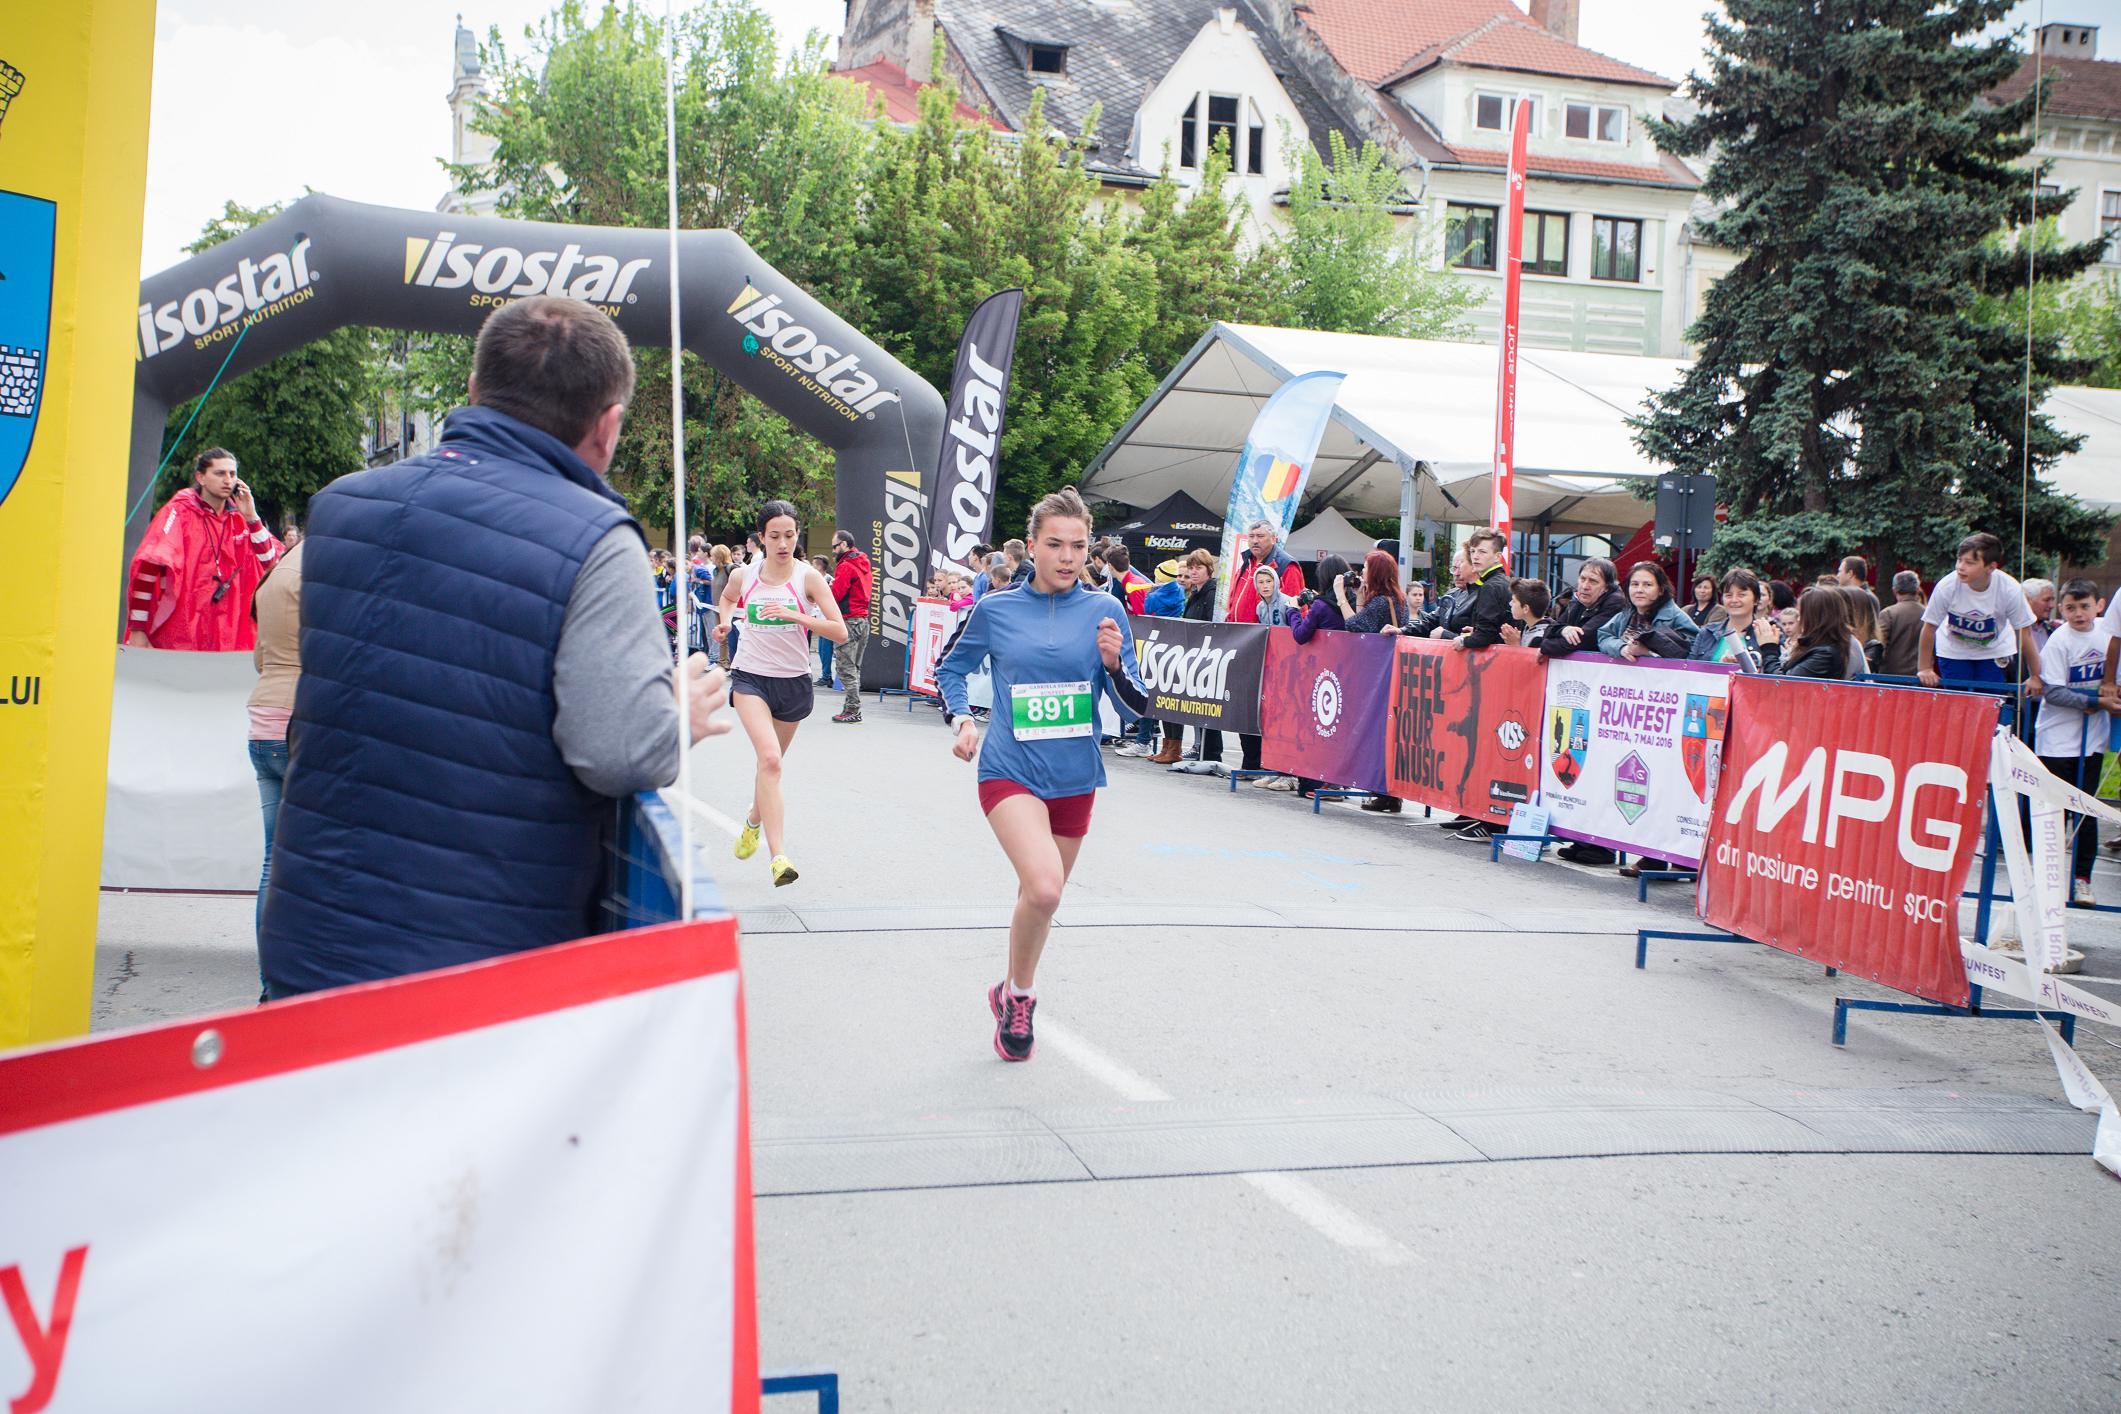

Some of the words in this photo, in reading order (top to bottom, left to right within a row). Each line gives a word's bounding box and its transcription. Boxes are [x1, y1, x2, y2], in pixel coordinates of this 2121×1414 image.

[415, 231, 652, 303] isostar
[139, 238, 311, 358] isostar
[194, 320, 240, 350] SPORT
[243, 286, 314, 327] NUTRITION
[469, 294, 514, 309] SPO
[733, 294, 901, 414] isostar
[760, 346, 800, 377] SPORT
[798, 375, 859, 422] NUTRITION
[931, 342, 1004, 579] isostar
[873, 520, 882, 563] SPORT
[1148, 535, 1189, 548] isostar
[1175, 522, 1222, 532] isostar
[871, 568, 881, 635] NUTRITION
[1955, 617, 1985, 632] 170
[1140, 630, 1237, 700] isostar
[1398, 652, 1444, 714] FEEL
[1027, 695, 1074, 721] 891
[1156, 696, 1179, 711] SPORT
[1181, 701, 1222, 717] NUTRITION
[1599, 700, 1677, 734] RUNFEST
[1600, 685, 1644, 701] GABRIELA
[1648, 690, 1679, 704] SZABO
[1393, 706, 1434, 749] YOUR
[1640, 735, 1654, 745] MAI
[1656, 737, 1672, 748] 2016
[1394, 743, 1445, 791] MUSIC
[1725, 741, 1968, 872] MPG
[1717, 839, 1739, 868] din
[1747, 851, 1819, 890] pasiune
[1827, 872, 1894, 911] pentru
[1904, 892, 1947, 925] spo
[2061, 993, 2112, 1020] RUNFEST
